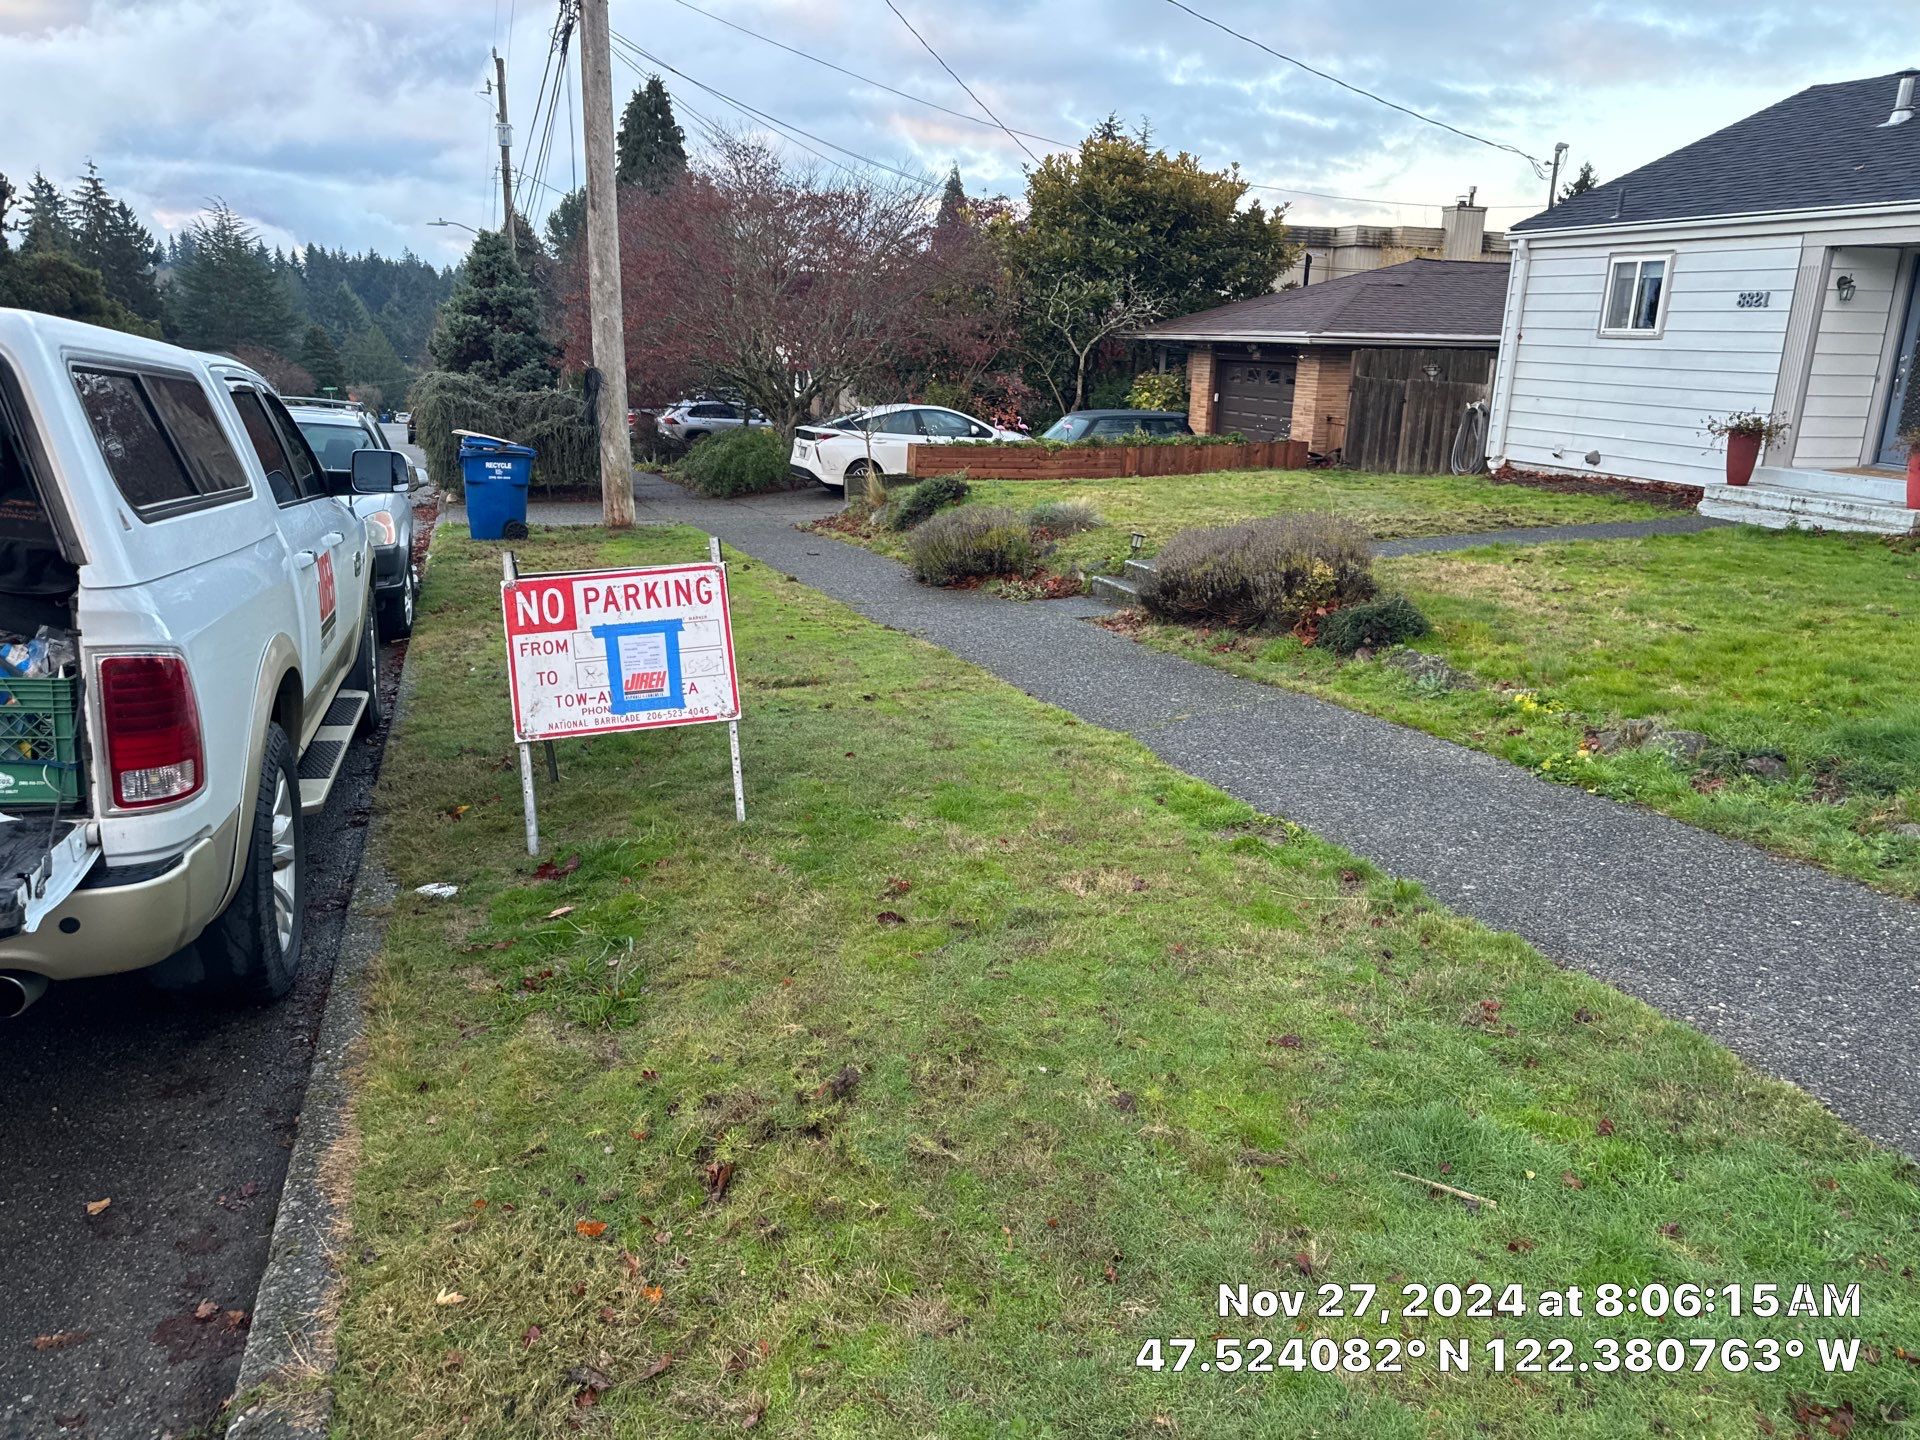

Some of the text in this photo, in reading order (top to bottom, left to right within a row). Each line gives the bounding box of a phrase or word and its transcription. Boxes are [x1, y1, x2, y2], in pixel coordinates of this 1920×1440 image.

[485, 462, 512, 470] RECYCLE
[515, 576, 713, 627] NO PARKING
[519, 639, 569, 657] FROM
[536, 670, 559, 686] TO
[624, 671, 667, 691] JIREH
[548, 707, 710, 731] NATIONAL BARRICADE 206-523-4045
[581, 706, 612, 716] PHON
